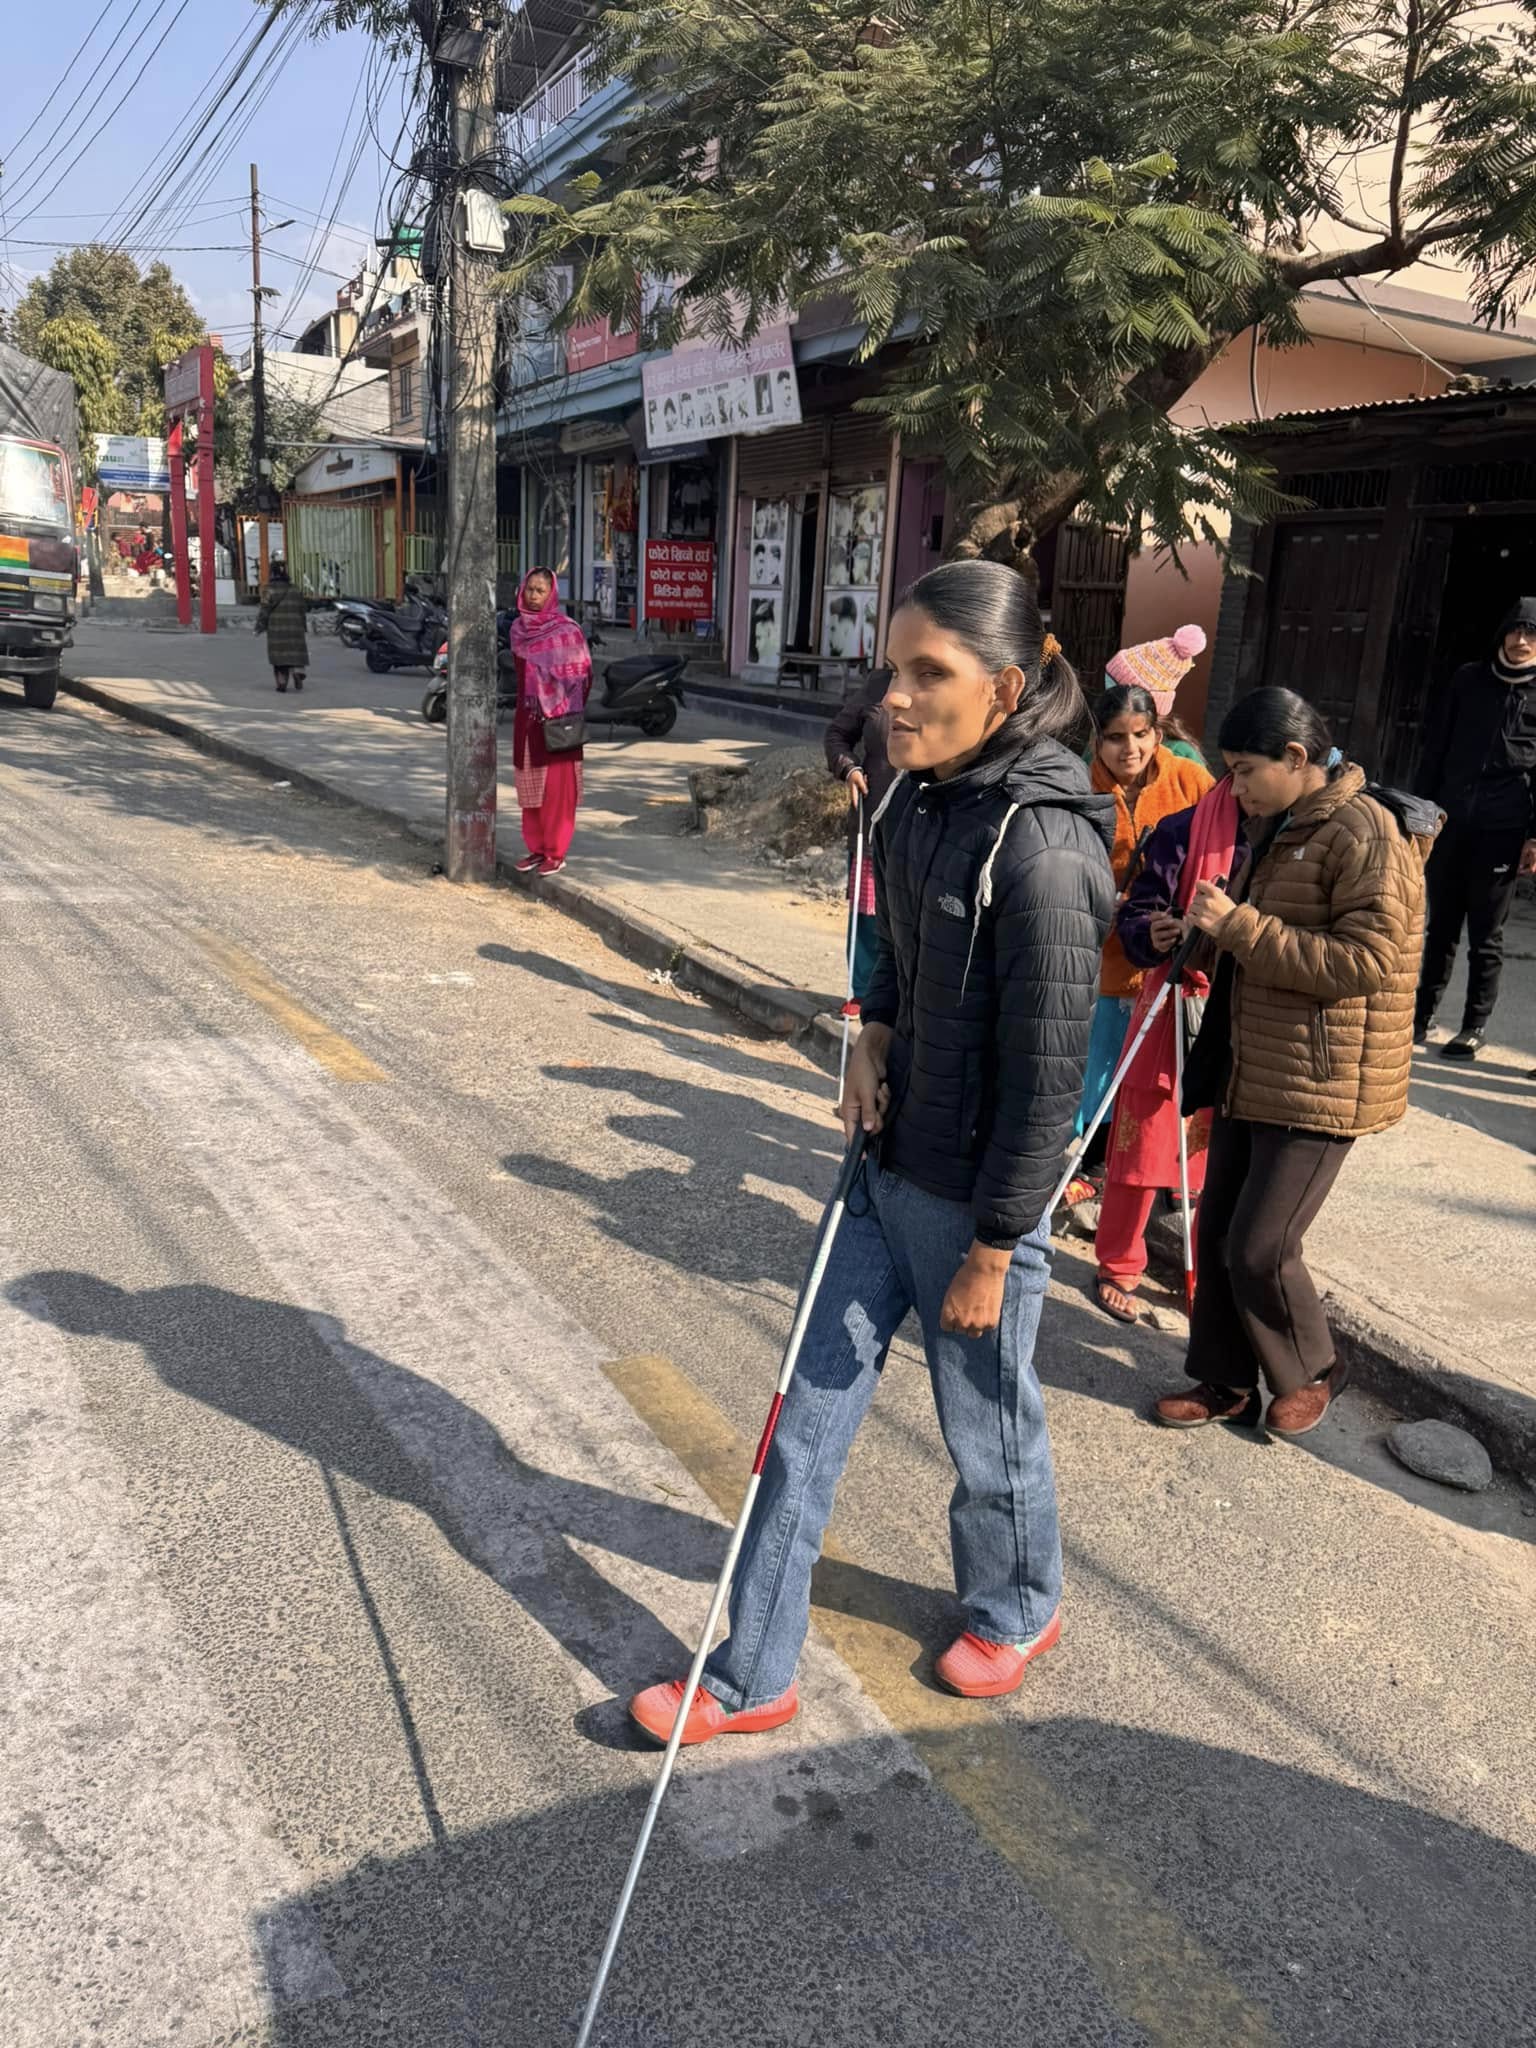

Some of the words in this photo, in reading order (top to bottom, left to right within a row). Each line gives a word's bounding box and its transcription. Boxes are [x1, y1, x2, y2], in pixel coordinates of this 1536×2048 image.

[648, 545, 670, 560] फोटो
[650, 567, 670, 580] फोटो
[688, 568, 708, 582] फोटो
